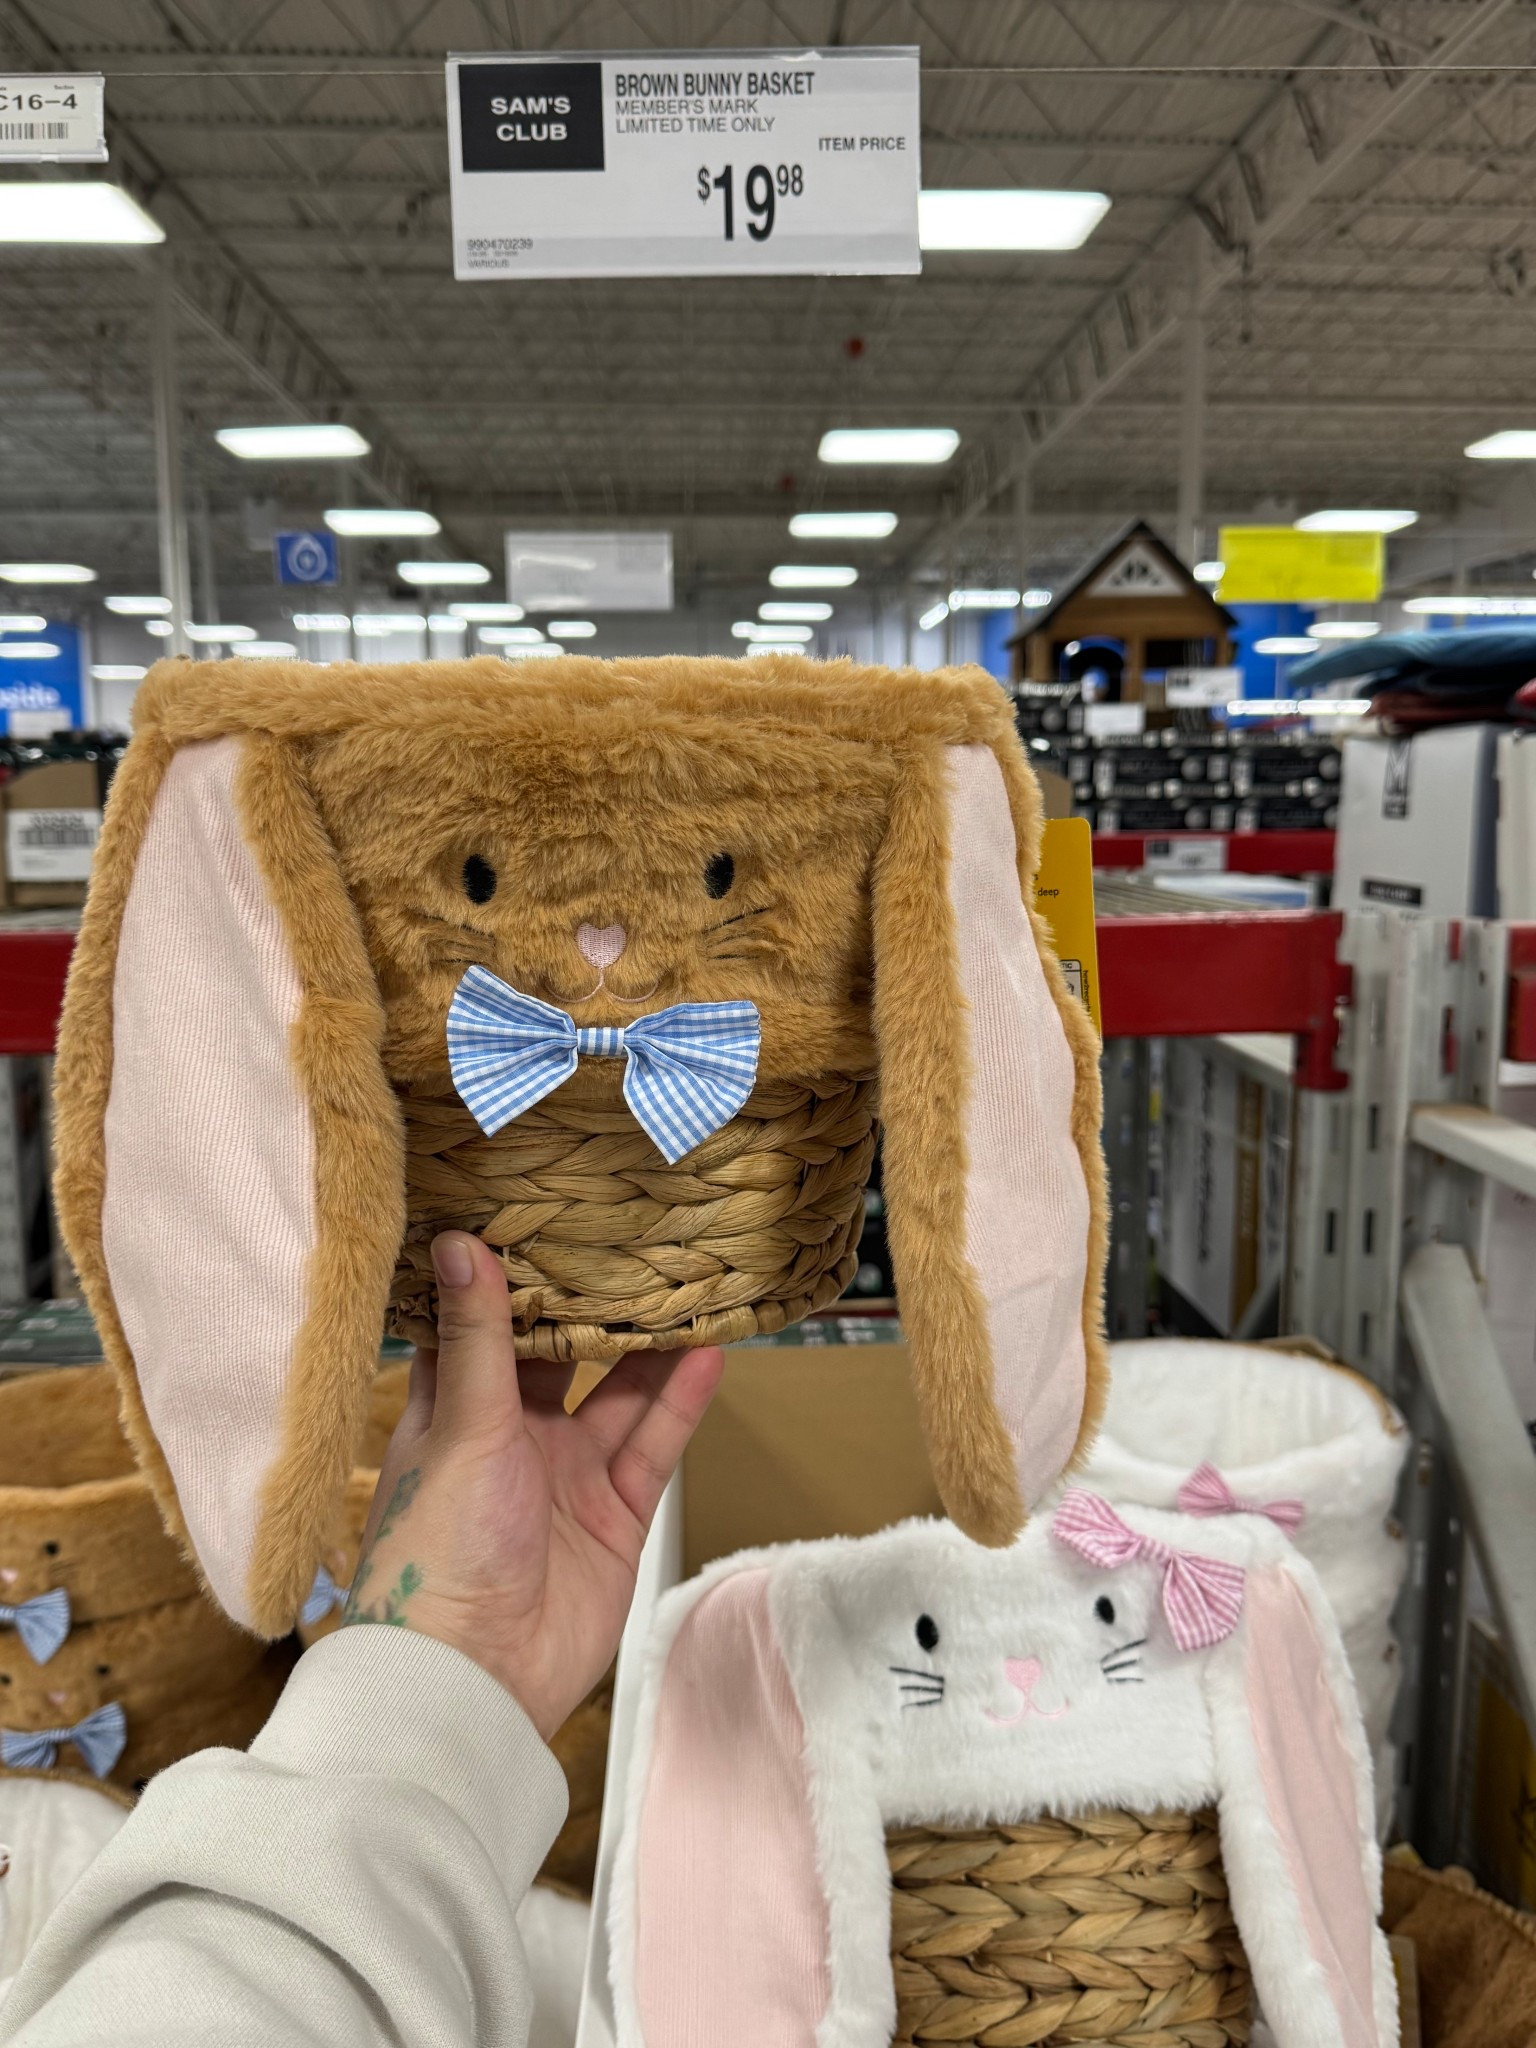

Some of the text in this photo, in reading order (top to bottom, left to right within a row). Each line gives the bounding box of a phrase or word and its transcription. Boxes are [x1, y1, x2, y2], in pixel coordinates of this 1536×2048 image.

[615, 72, 815, 97] BROWN BUNNY BASKET
[490, 96, 571, 115] SAM'S
[616, 99, 758, 115] MEMBER'S MARK
[496, 123, 568, 142] CLUB
[616, 117, 775, 133] LIMITED TIME ONLY
[818, 136, 906, 151] ITEM PRICE
[1037, 887, 1060, 899] deep
